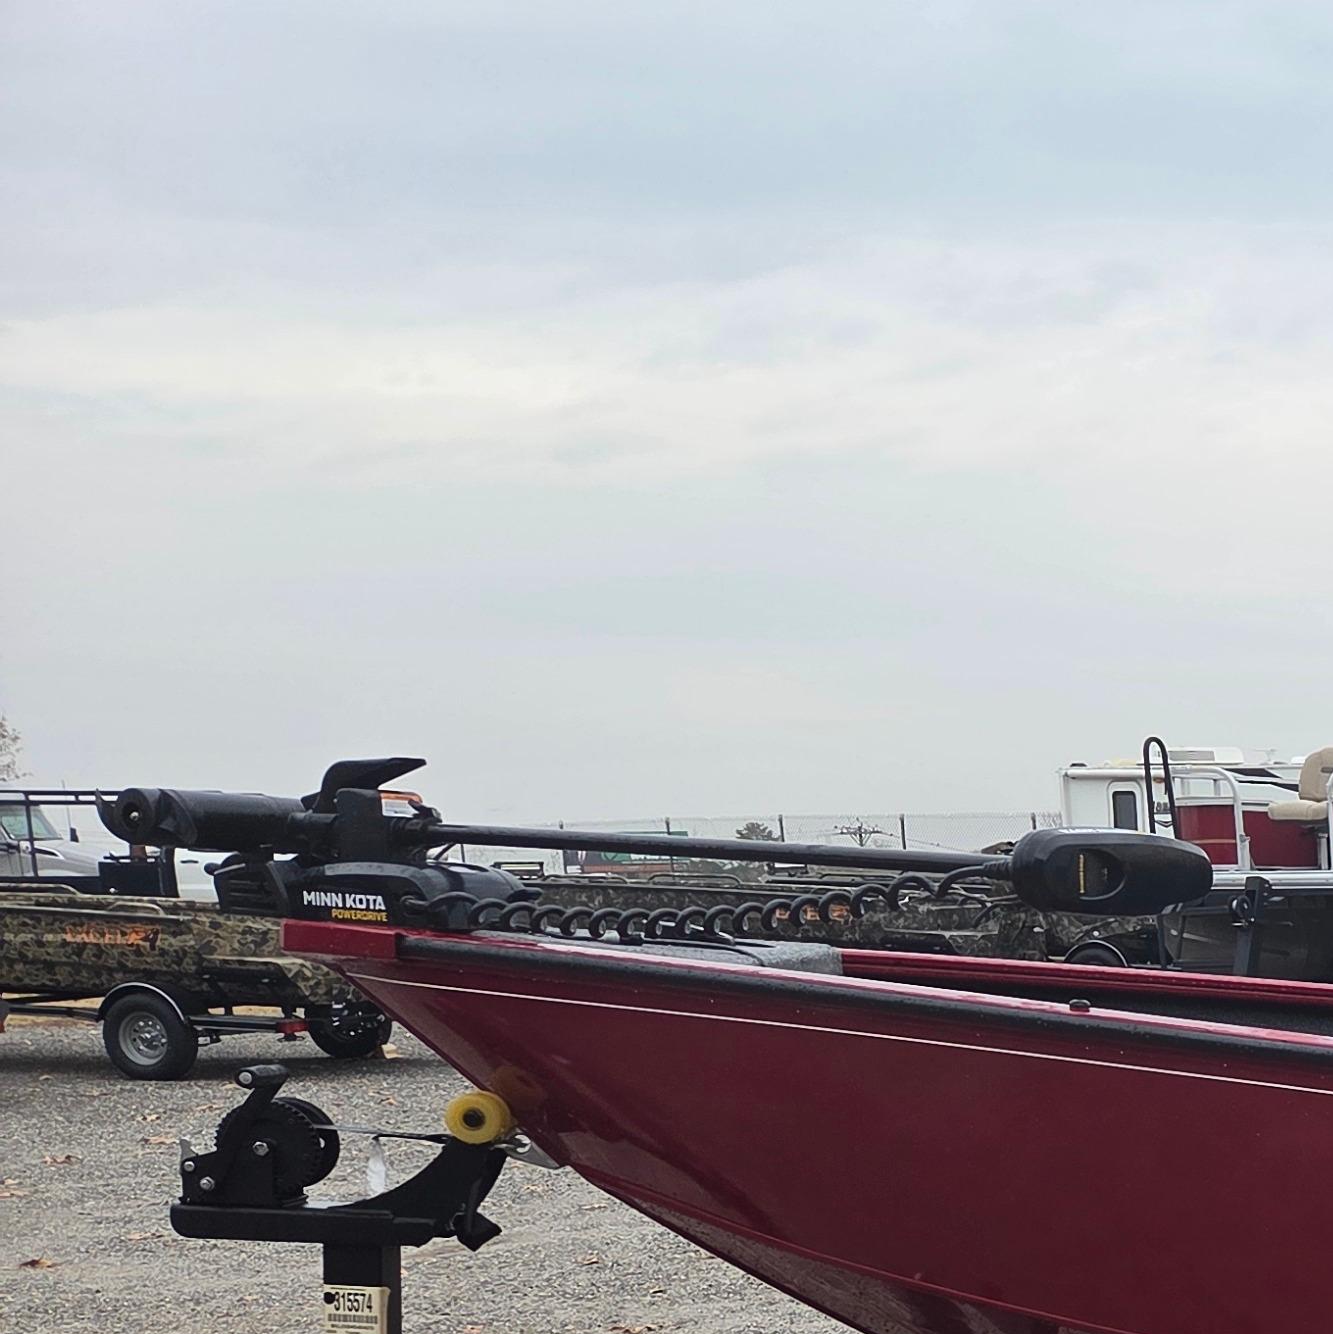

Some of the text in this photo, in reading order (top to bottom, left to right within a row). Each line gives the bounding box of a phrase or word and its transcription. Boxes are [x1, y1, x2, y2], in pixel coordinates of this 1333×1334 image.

[303, 890, 386, 910] MINN KOTA
[331, 908, 388, 922] POWERDRIVE
[333, 1291, 373, 1313] 315574
